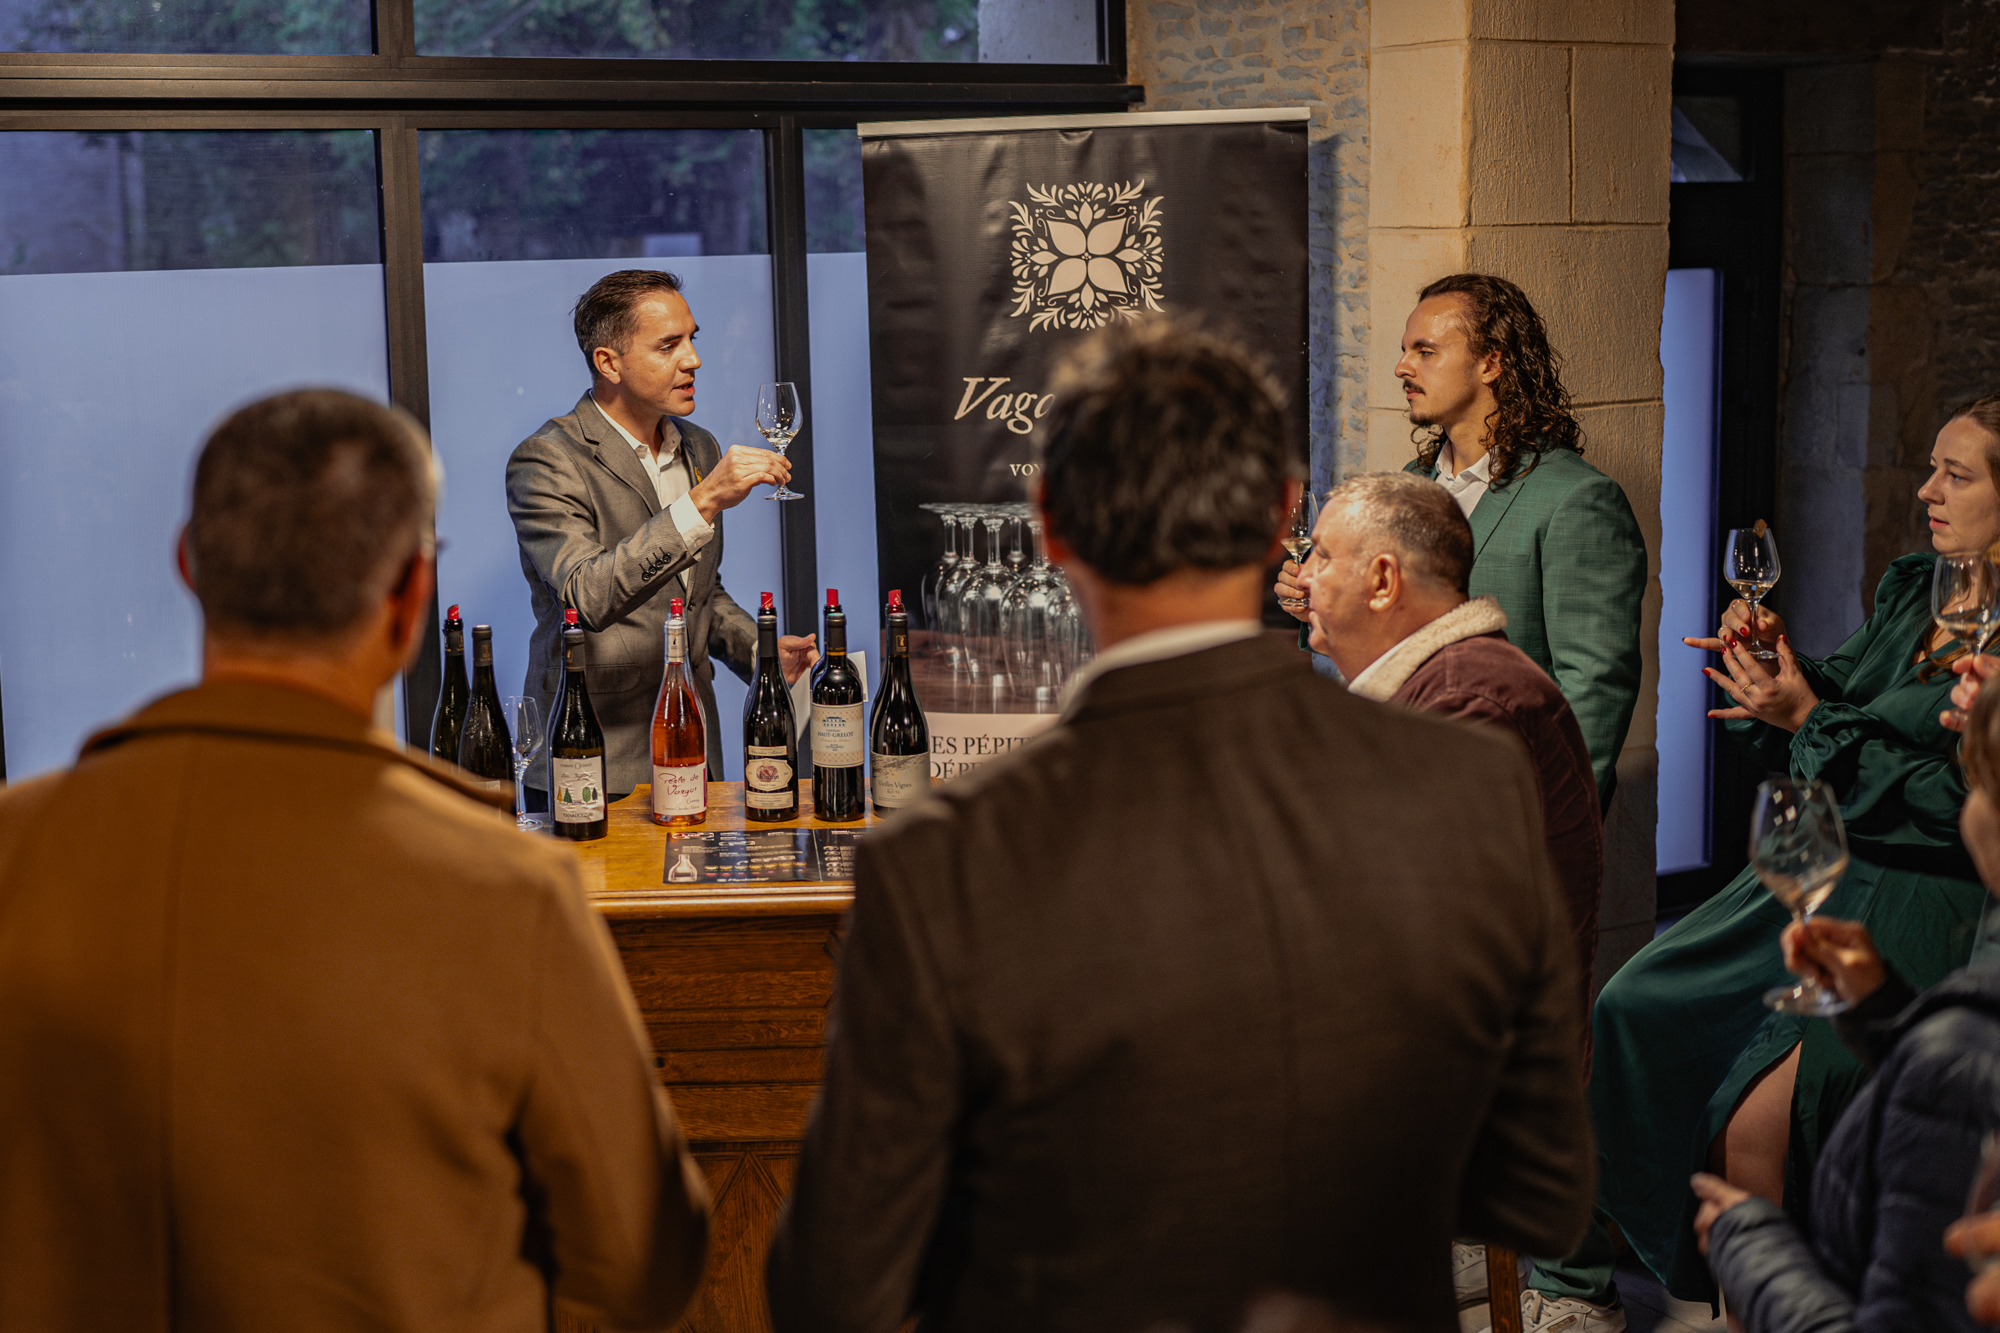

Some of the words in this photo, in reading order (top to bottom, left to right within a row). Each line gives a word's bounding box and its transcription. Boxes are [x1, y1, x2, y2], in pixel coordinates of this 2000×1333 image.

[930, 735, 957, 755] ES
[962, 733, 1036, 755] PÉPIT
[690, 773, 699, 782] de
[894, 781, 913, 790] Vignes
